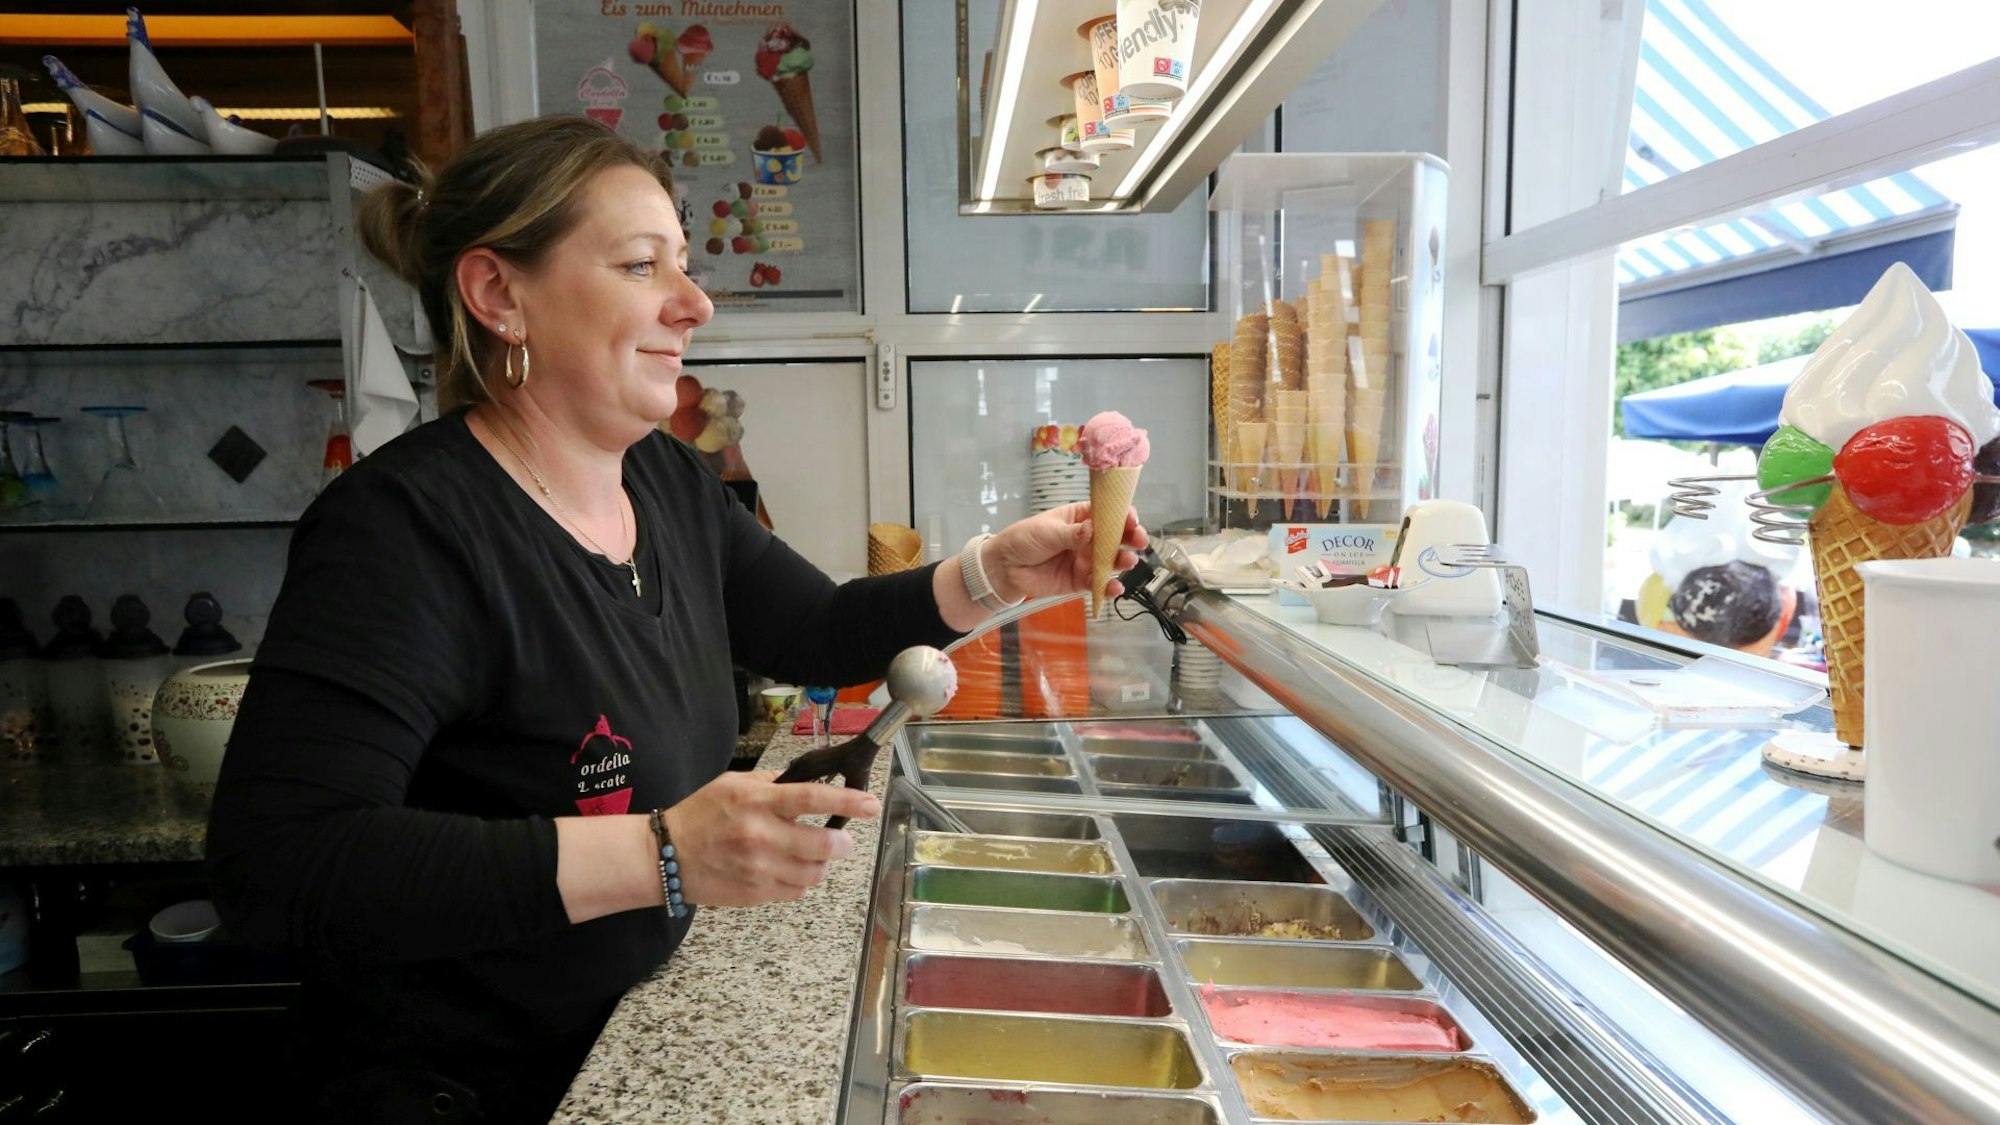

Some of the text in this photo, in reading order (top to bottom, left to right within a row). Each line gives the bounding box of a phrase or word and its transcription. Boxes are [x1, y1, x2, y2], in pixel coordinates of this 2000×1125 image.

[600, 0, 786, 17] Eis zum Mitnehmen
[1322, 534, 1374, 552] DECOR
[580, 752, 631, 776] ordella
